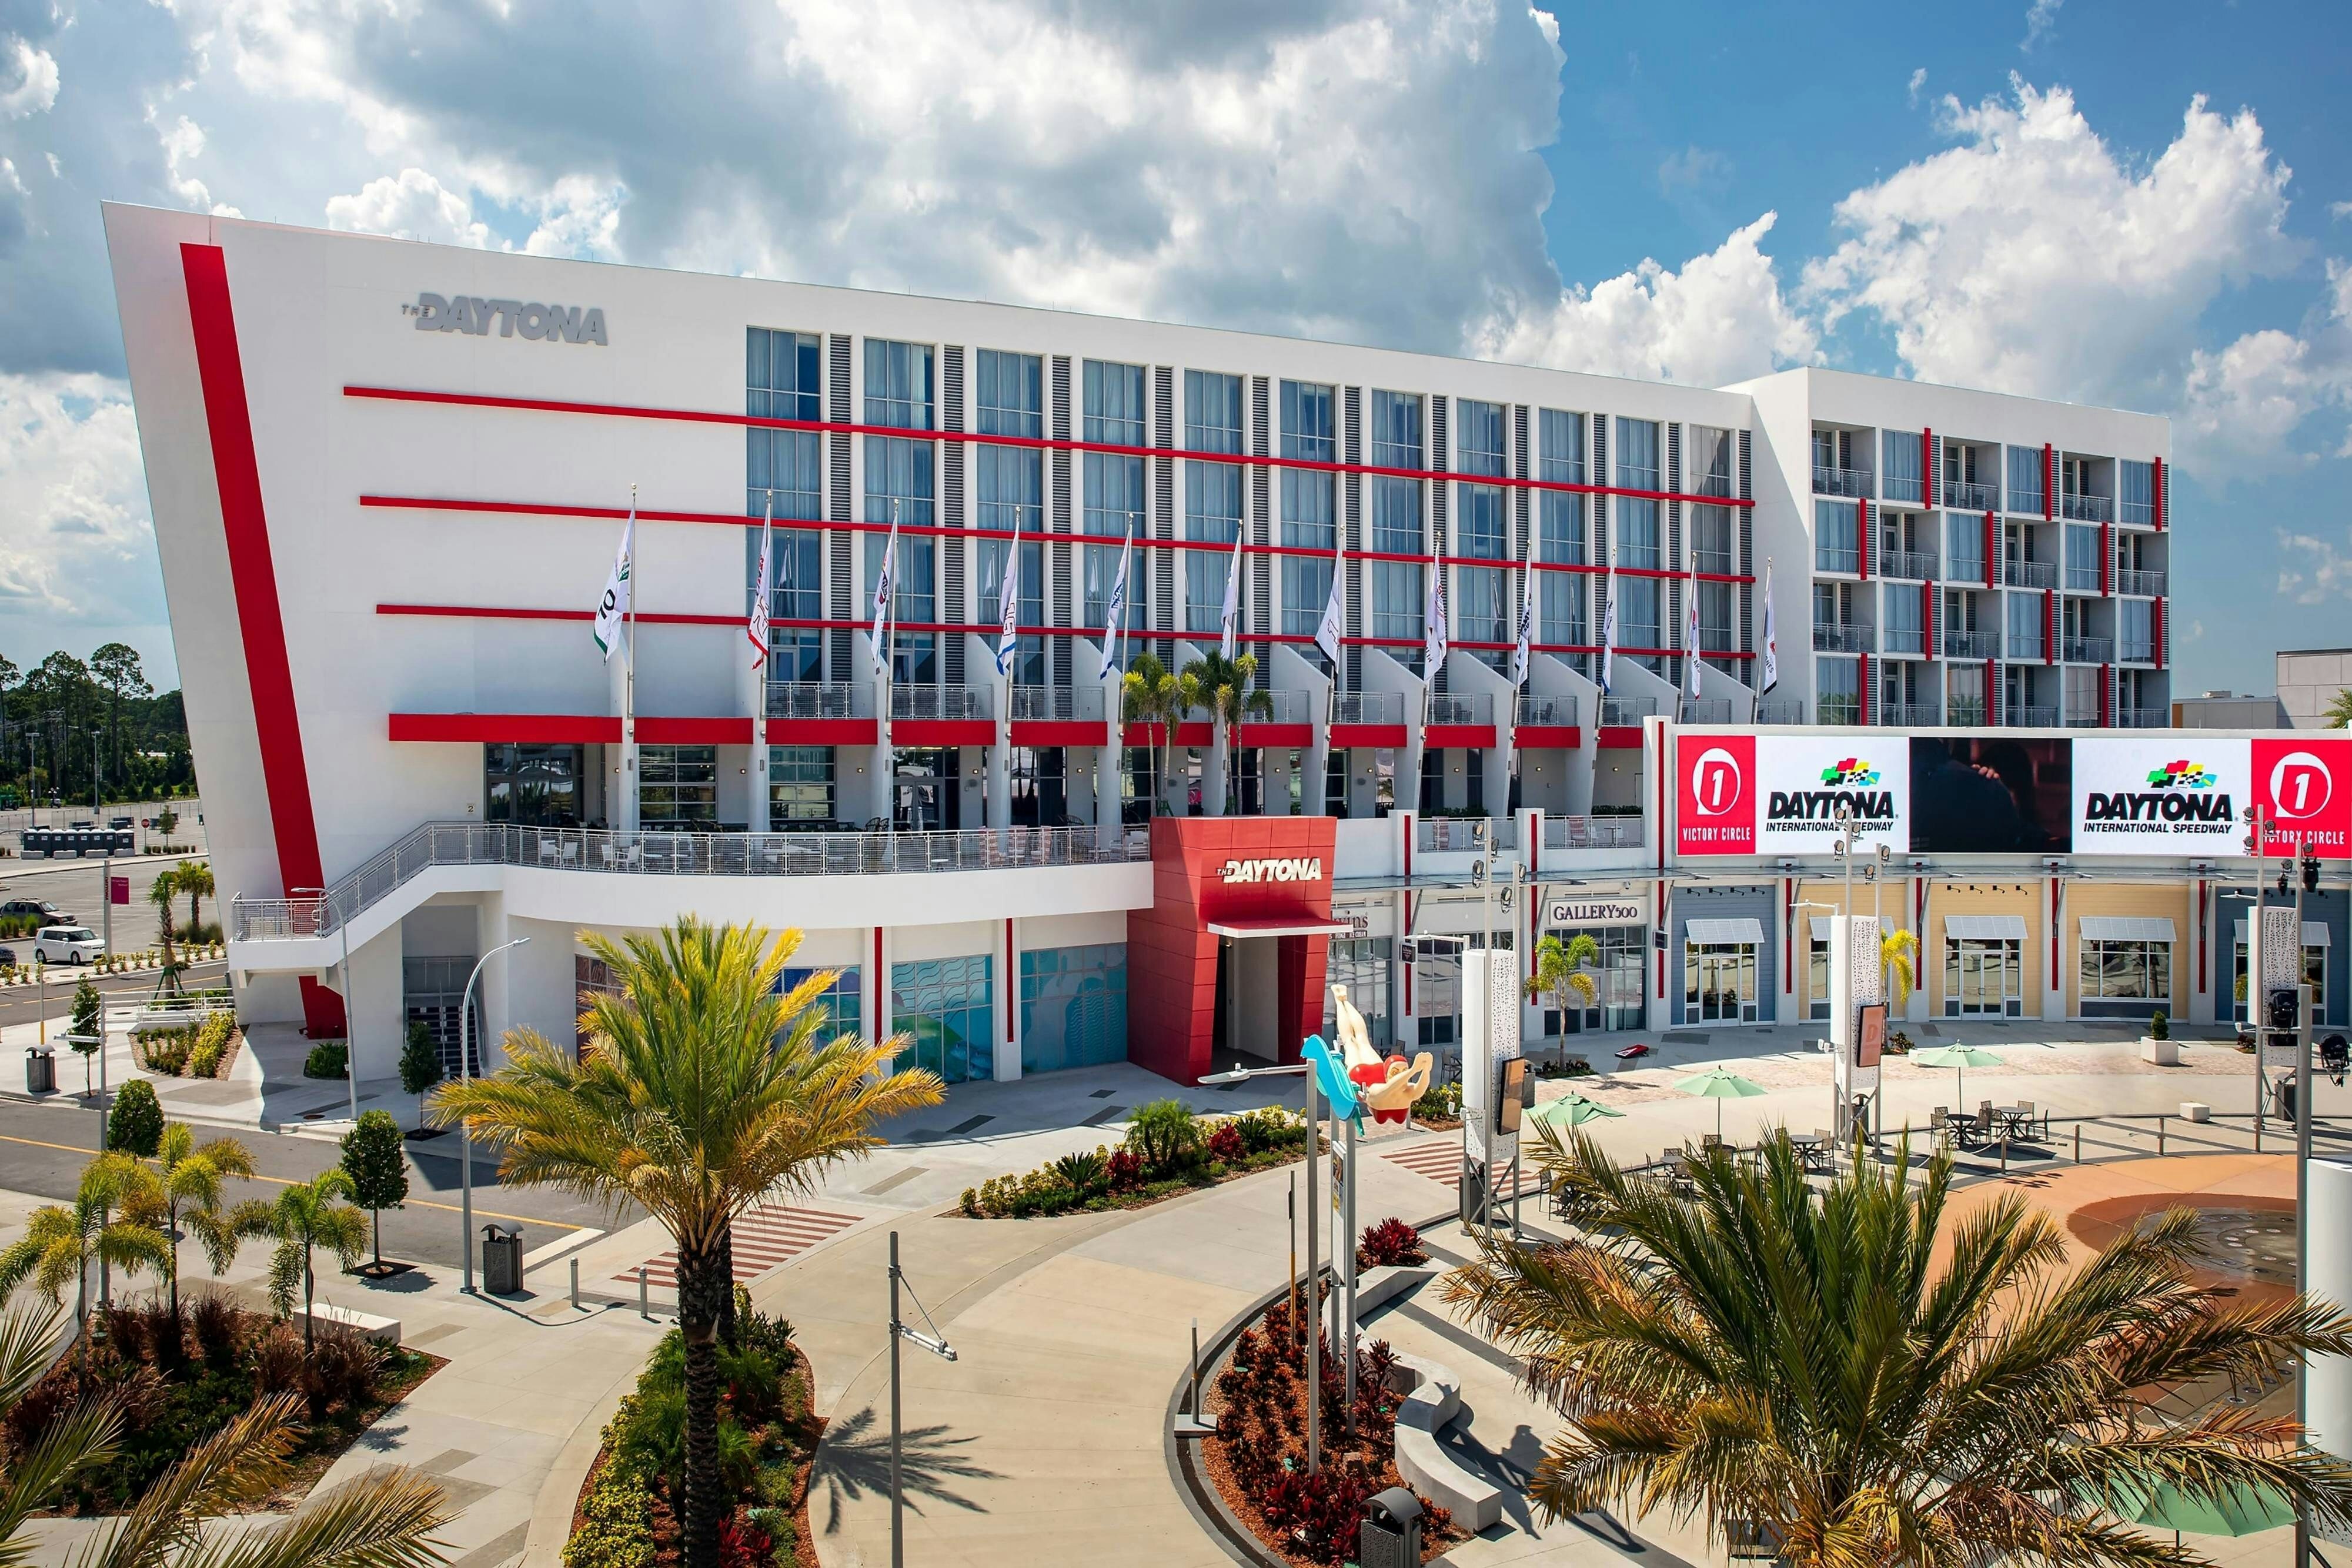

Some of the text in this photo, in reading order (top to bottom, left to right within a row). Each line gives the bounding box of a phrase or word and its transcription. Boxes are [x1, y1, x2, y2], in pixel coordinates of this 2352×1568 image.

[401, 292, 608, 346] THE DAYTONA
[1768, 791, 1895, 819] DAYTONA
[2086, 793, 2233, 822] DAYTONA
[1682, 827, 1750, 841] VICTORY CIRCLE
[1843, 822, 1894, 831] EDWAY
[2084, 823, 2232, 834] INTERNATIONAL SPEEDWAY
[2259, 830, 2344, 844] ICTORY CIRCLE
[1224, 858, 1322, 883] DAYTONA
